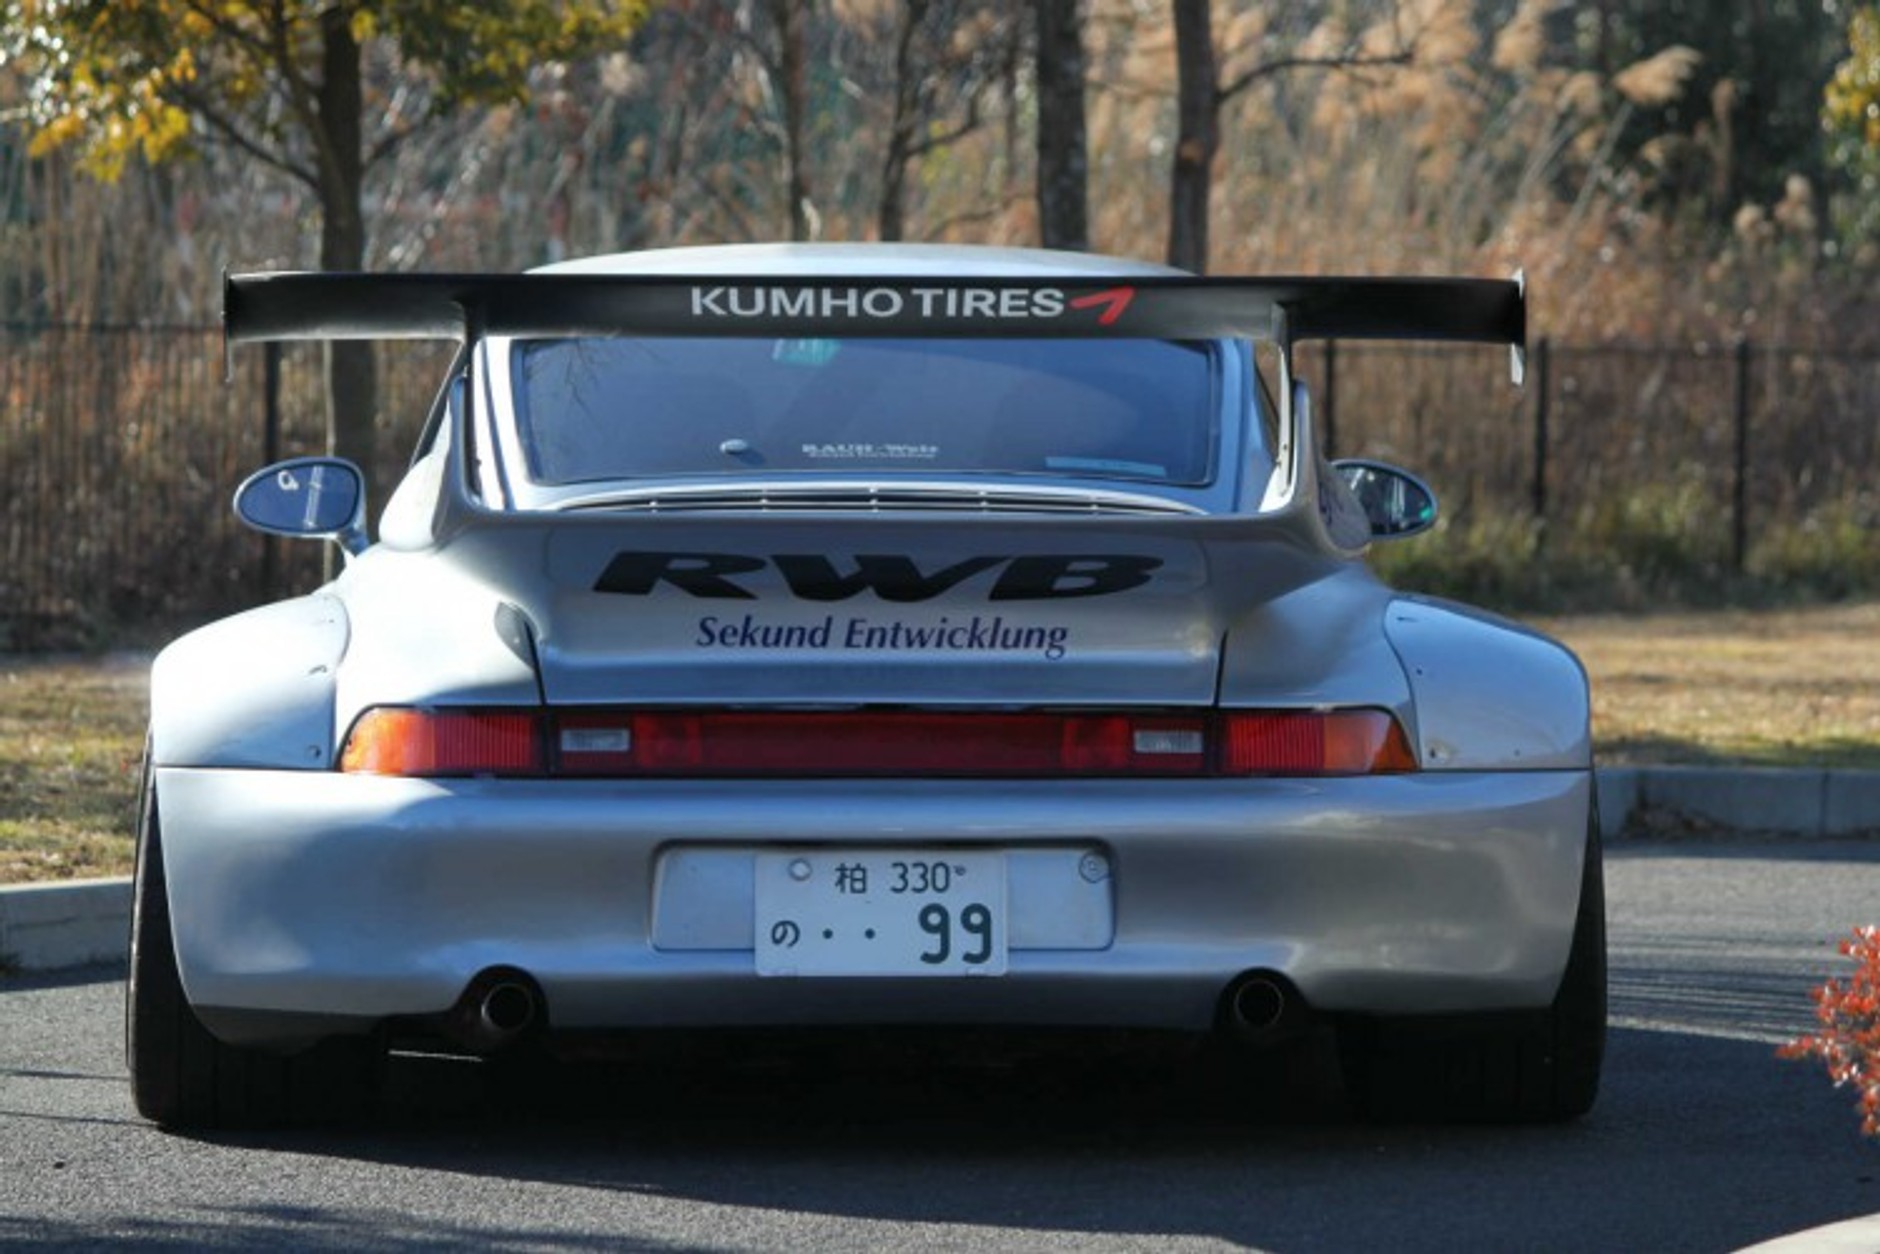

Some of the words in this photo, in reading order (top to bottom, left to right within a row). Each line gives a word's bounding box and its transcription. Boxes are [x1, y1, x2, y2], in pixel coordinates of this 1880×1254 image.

[690, 286, 903, 318] KUMHO
[911, 288, 1064, 318] TIRES
[592, 550, 1164, 602] RWB
[695, 615, 833, 649] Sekund
[843, 617, 1069, 660] Entwicklung
[835, 862, 867, 894] 柏
[889, 861, 950, 894] 330
[919, 902, 992, 965] 99
